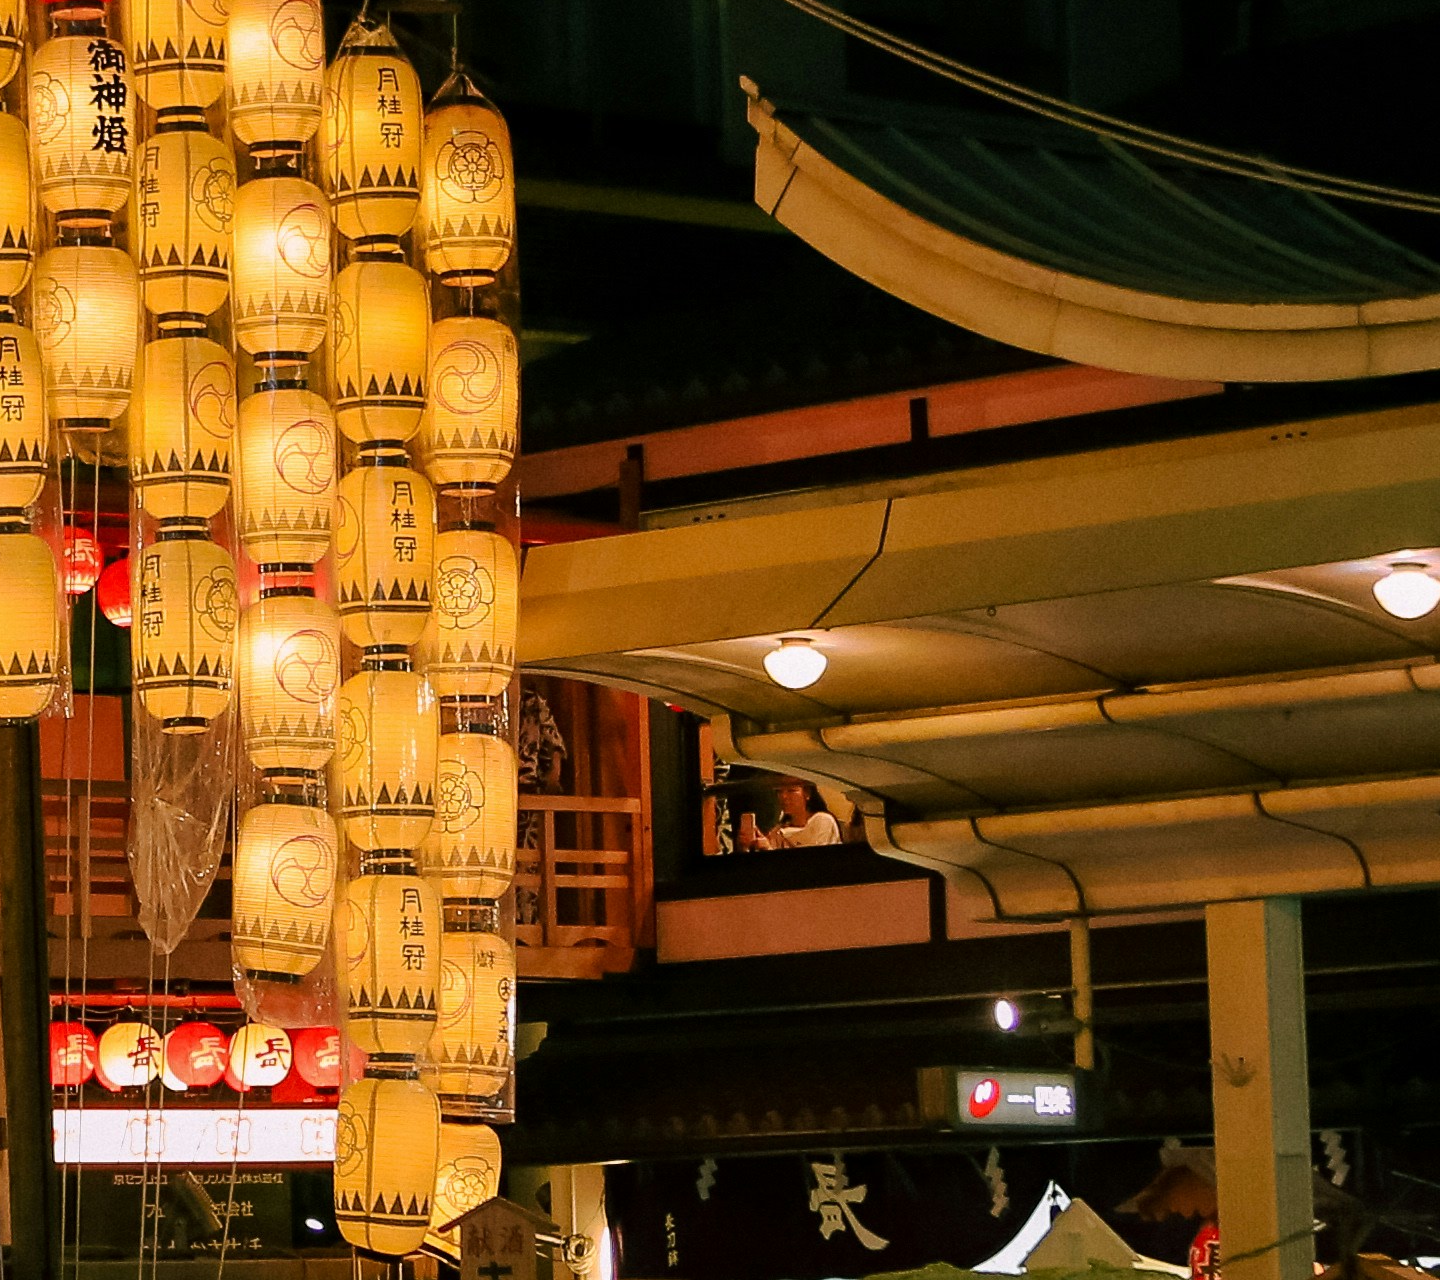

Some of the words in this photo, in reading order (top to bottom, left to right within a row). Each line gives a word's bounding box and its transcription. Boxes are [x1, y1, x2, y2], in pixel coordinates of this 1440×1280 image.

[377, 67, 404, 149] 月桂冠
[140, 146, 160, 228] 月桂冠
[390, 481, 417, 562] 月桂冠
[141, 554, 164, 639] 月桂冠
[399, 887, 425, 970] 月桂冠
